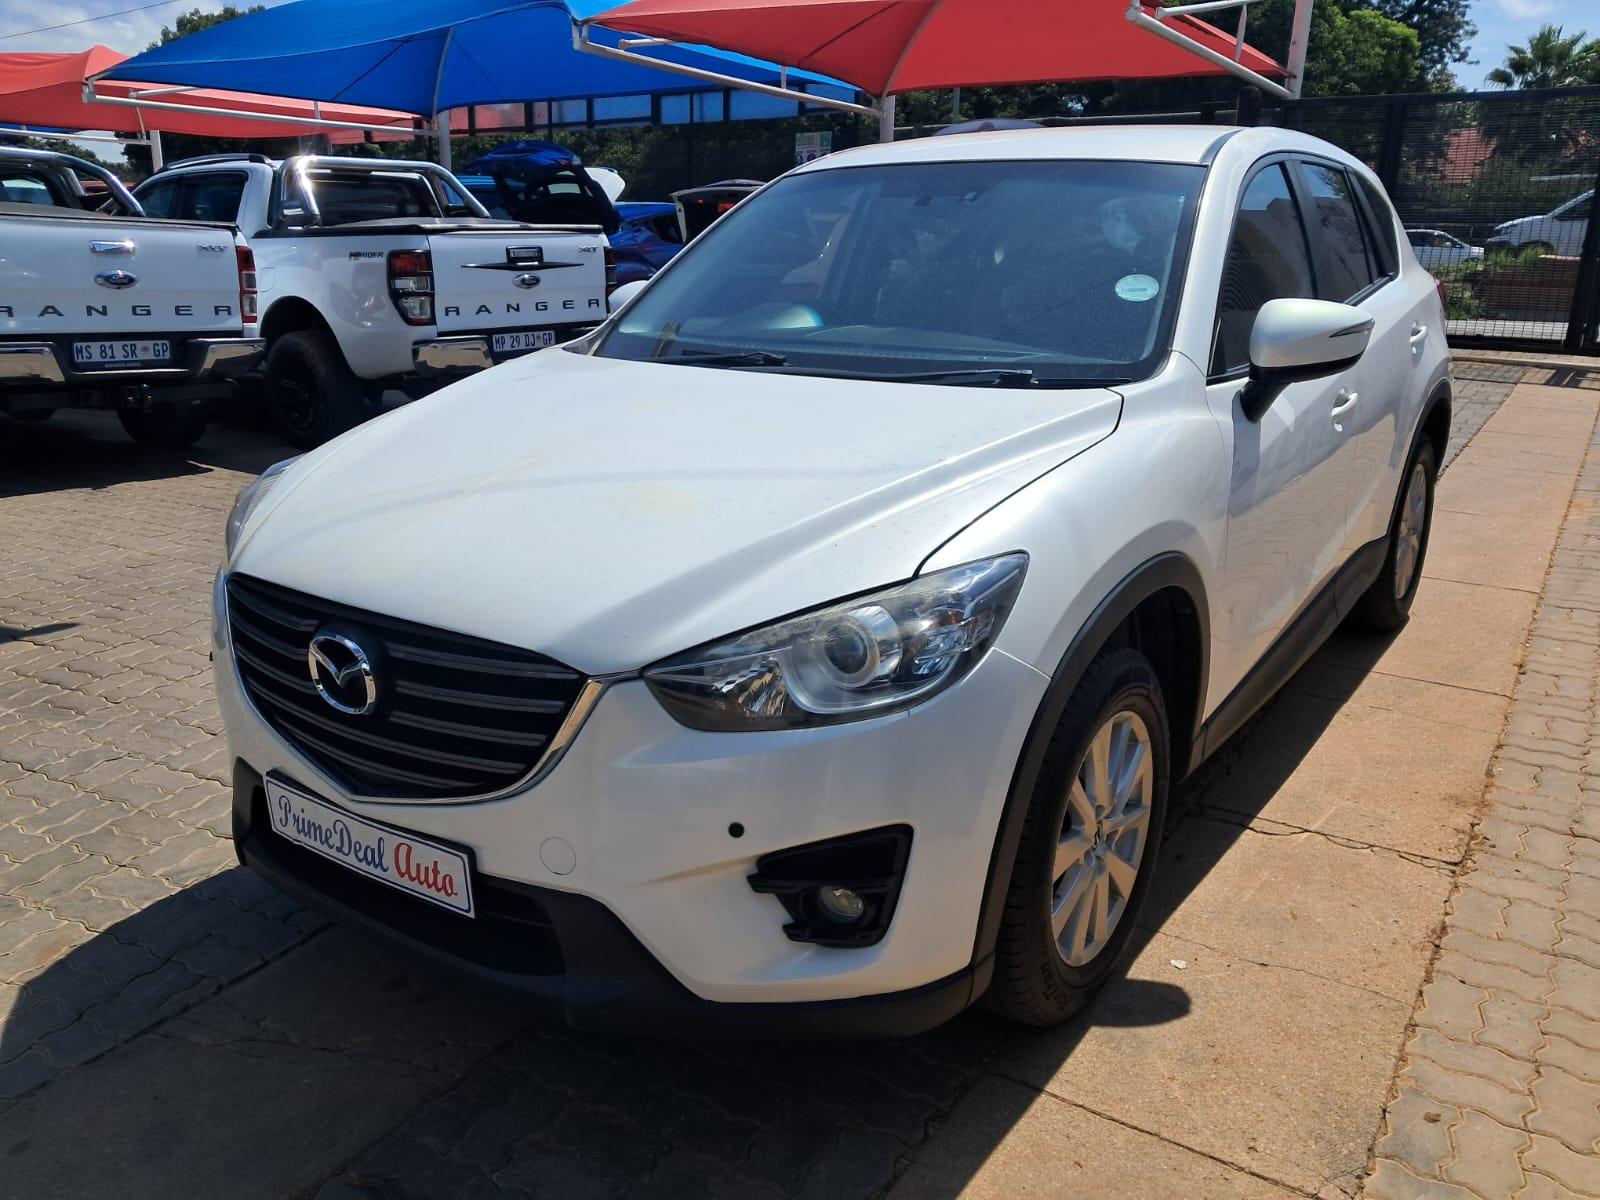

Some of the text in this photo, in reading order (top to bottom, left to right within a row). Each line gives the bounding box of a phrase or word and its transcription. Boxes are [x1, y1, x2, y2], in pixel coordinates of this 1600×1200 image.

[444, 298, 600, 316] RANGER
[494, 332, 553, 349] MP 29 DJ GP
[75, 342, 169, 360] MS 81 SR GP
[278, 795, 458, 897] PrimeDeal Auto
